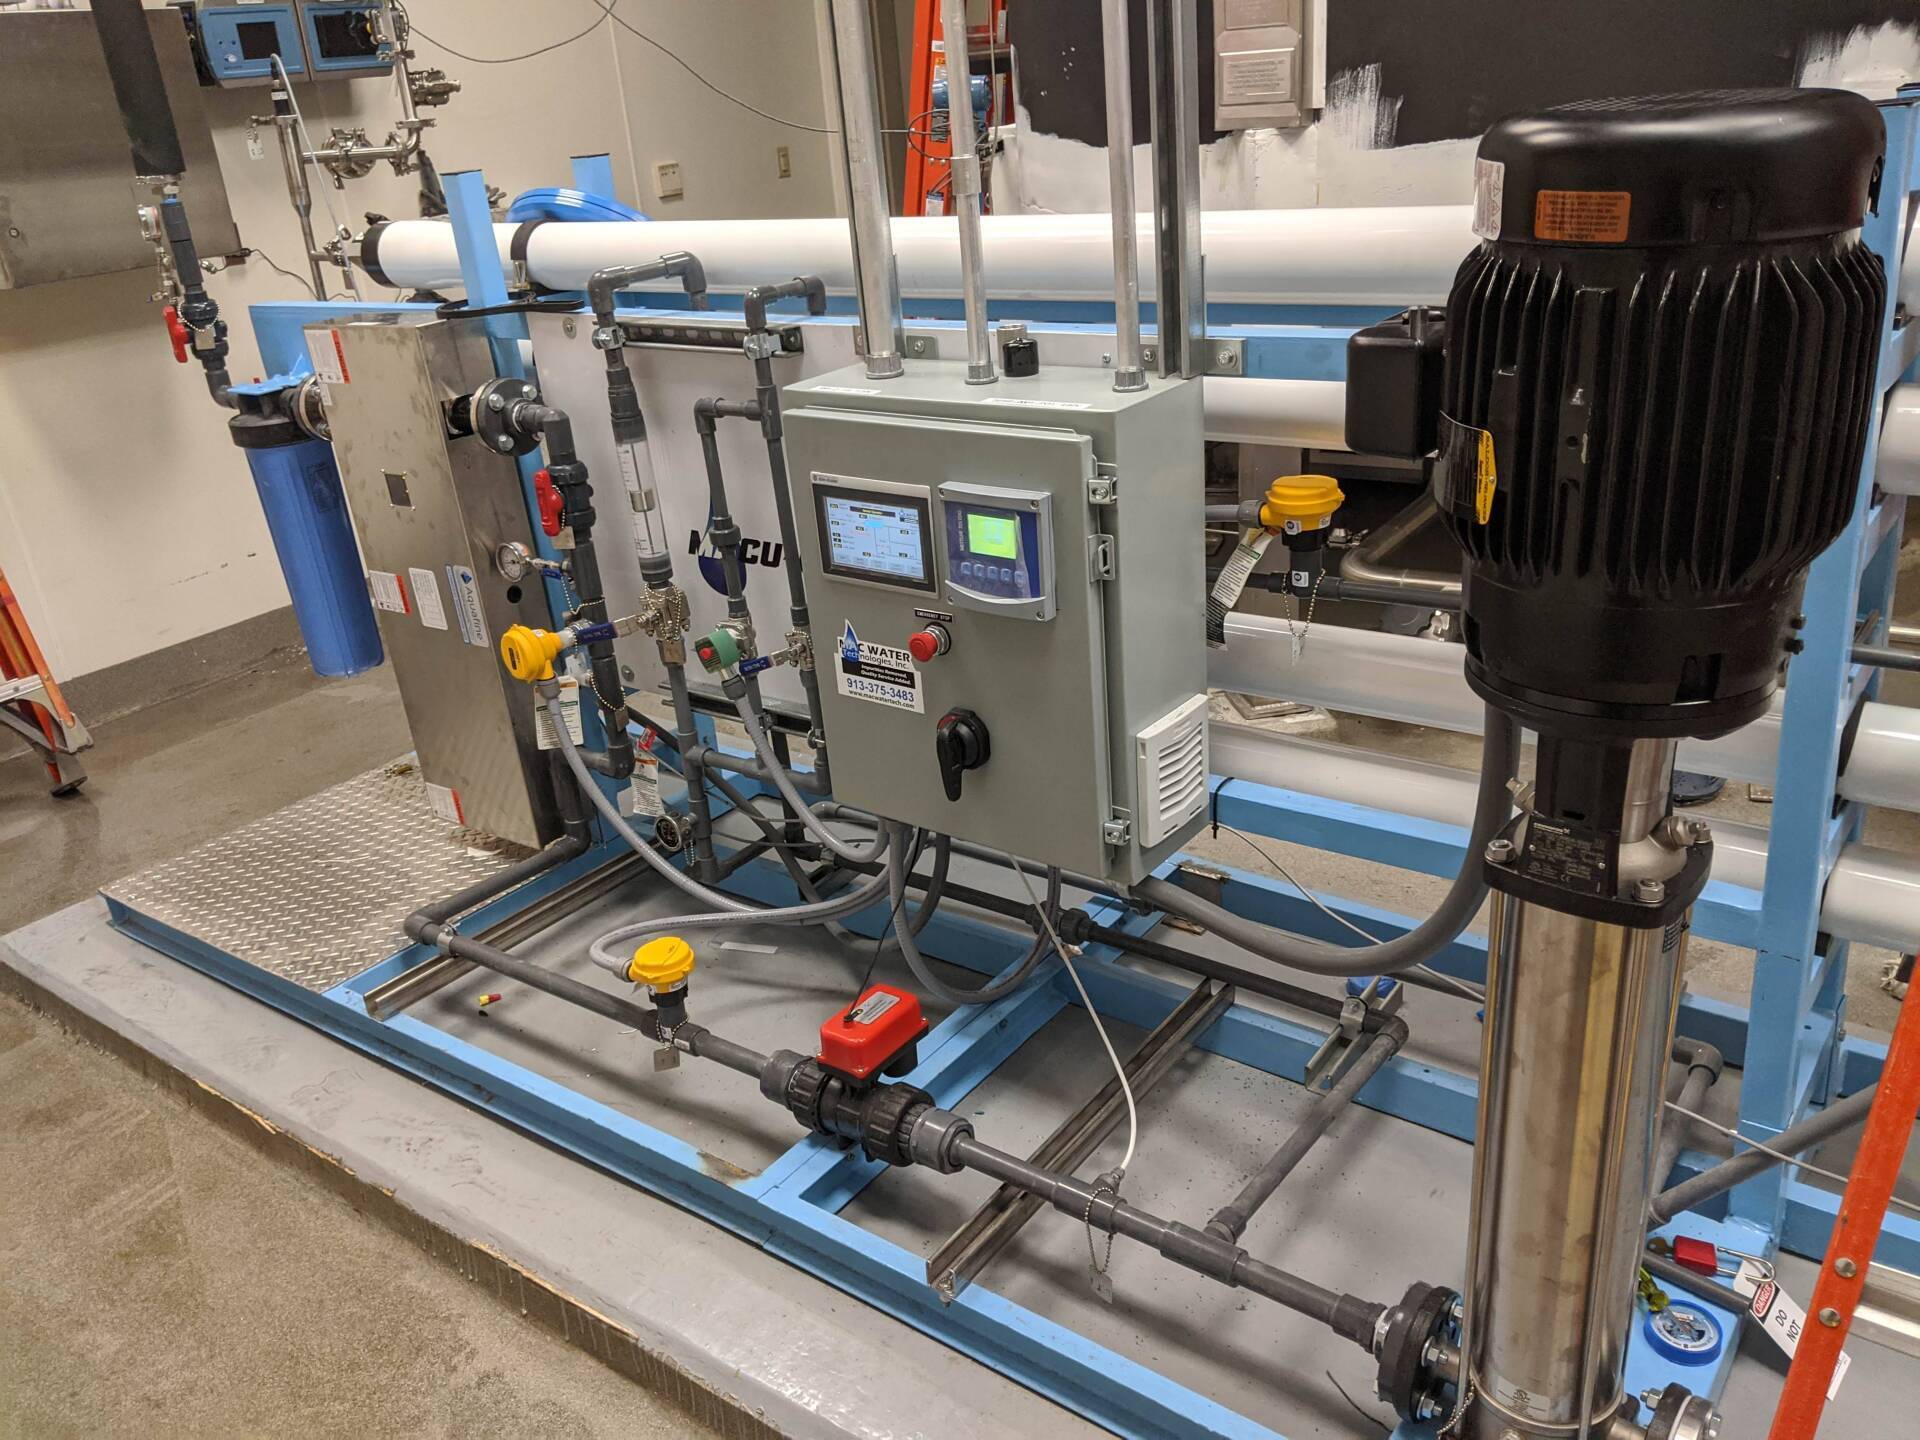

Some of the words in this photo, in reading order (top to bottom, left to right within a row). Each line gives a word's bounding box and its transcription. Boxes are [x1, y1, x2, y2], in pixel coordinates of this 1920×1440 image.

[465, 586, 483, 640] Aquafine
[867, 644, 911, 662] WATER
[895, 661, 910, 670] Inc.
[846, 677, 914, 702] 913-375-3483
[848, 689, 915, 709] www.macwatertech.com
[1755, 1283, 1773, 1312] DANGER
[1775, 1309, 1788, 1327] DO
[1786, 1319, 1801, 1343] NOT
